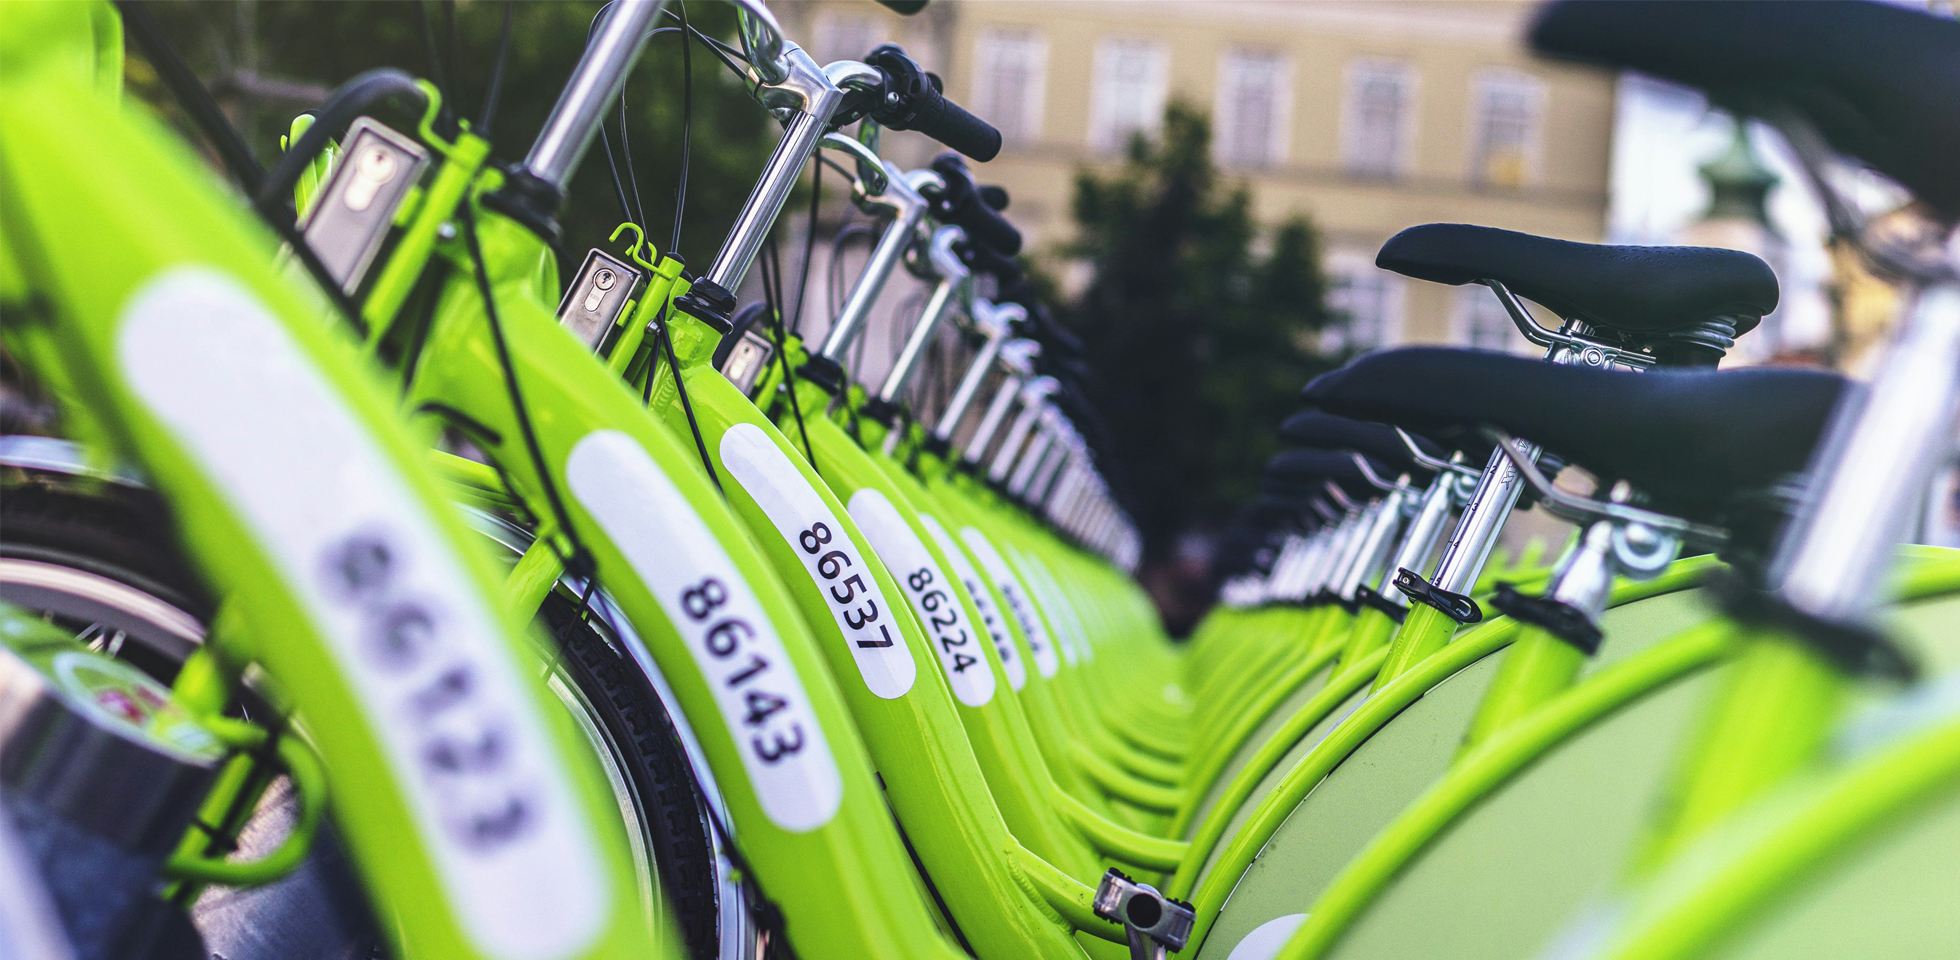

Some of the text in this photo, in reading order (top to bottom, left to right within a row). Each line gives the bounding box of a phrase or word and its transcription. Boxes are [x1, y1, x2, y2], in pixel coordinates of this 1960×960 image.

[799, 521, 894, 649] 86537
[907, 567, 978, 675] 86224
[680, 576, 806, 765] 86143
